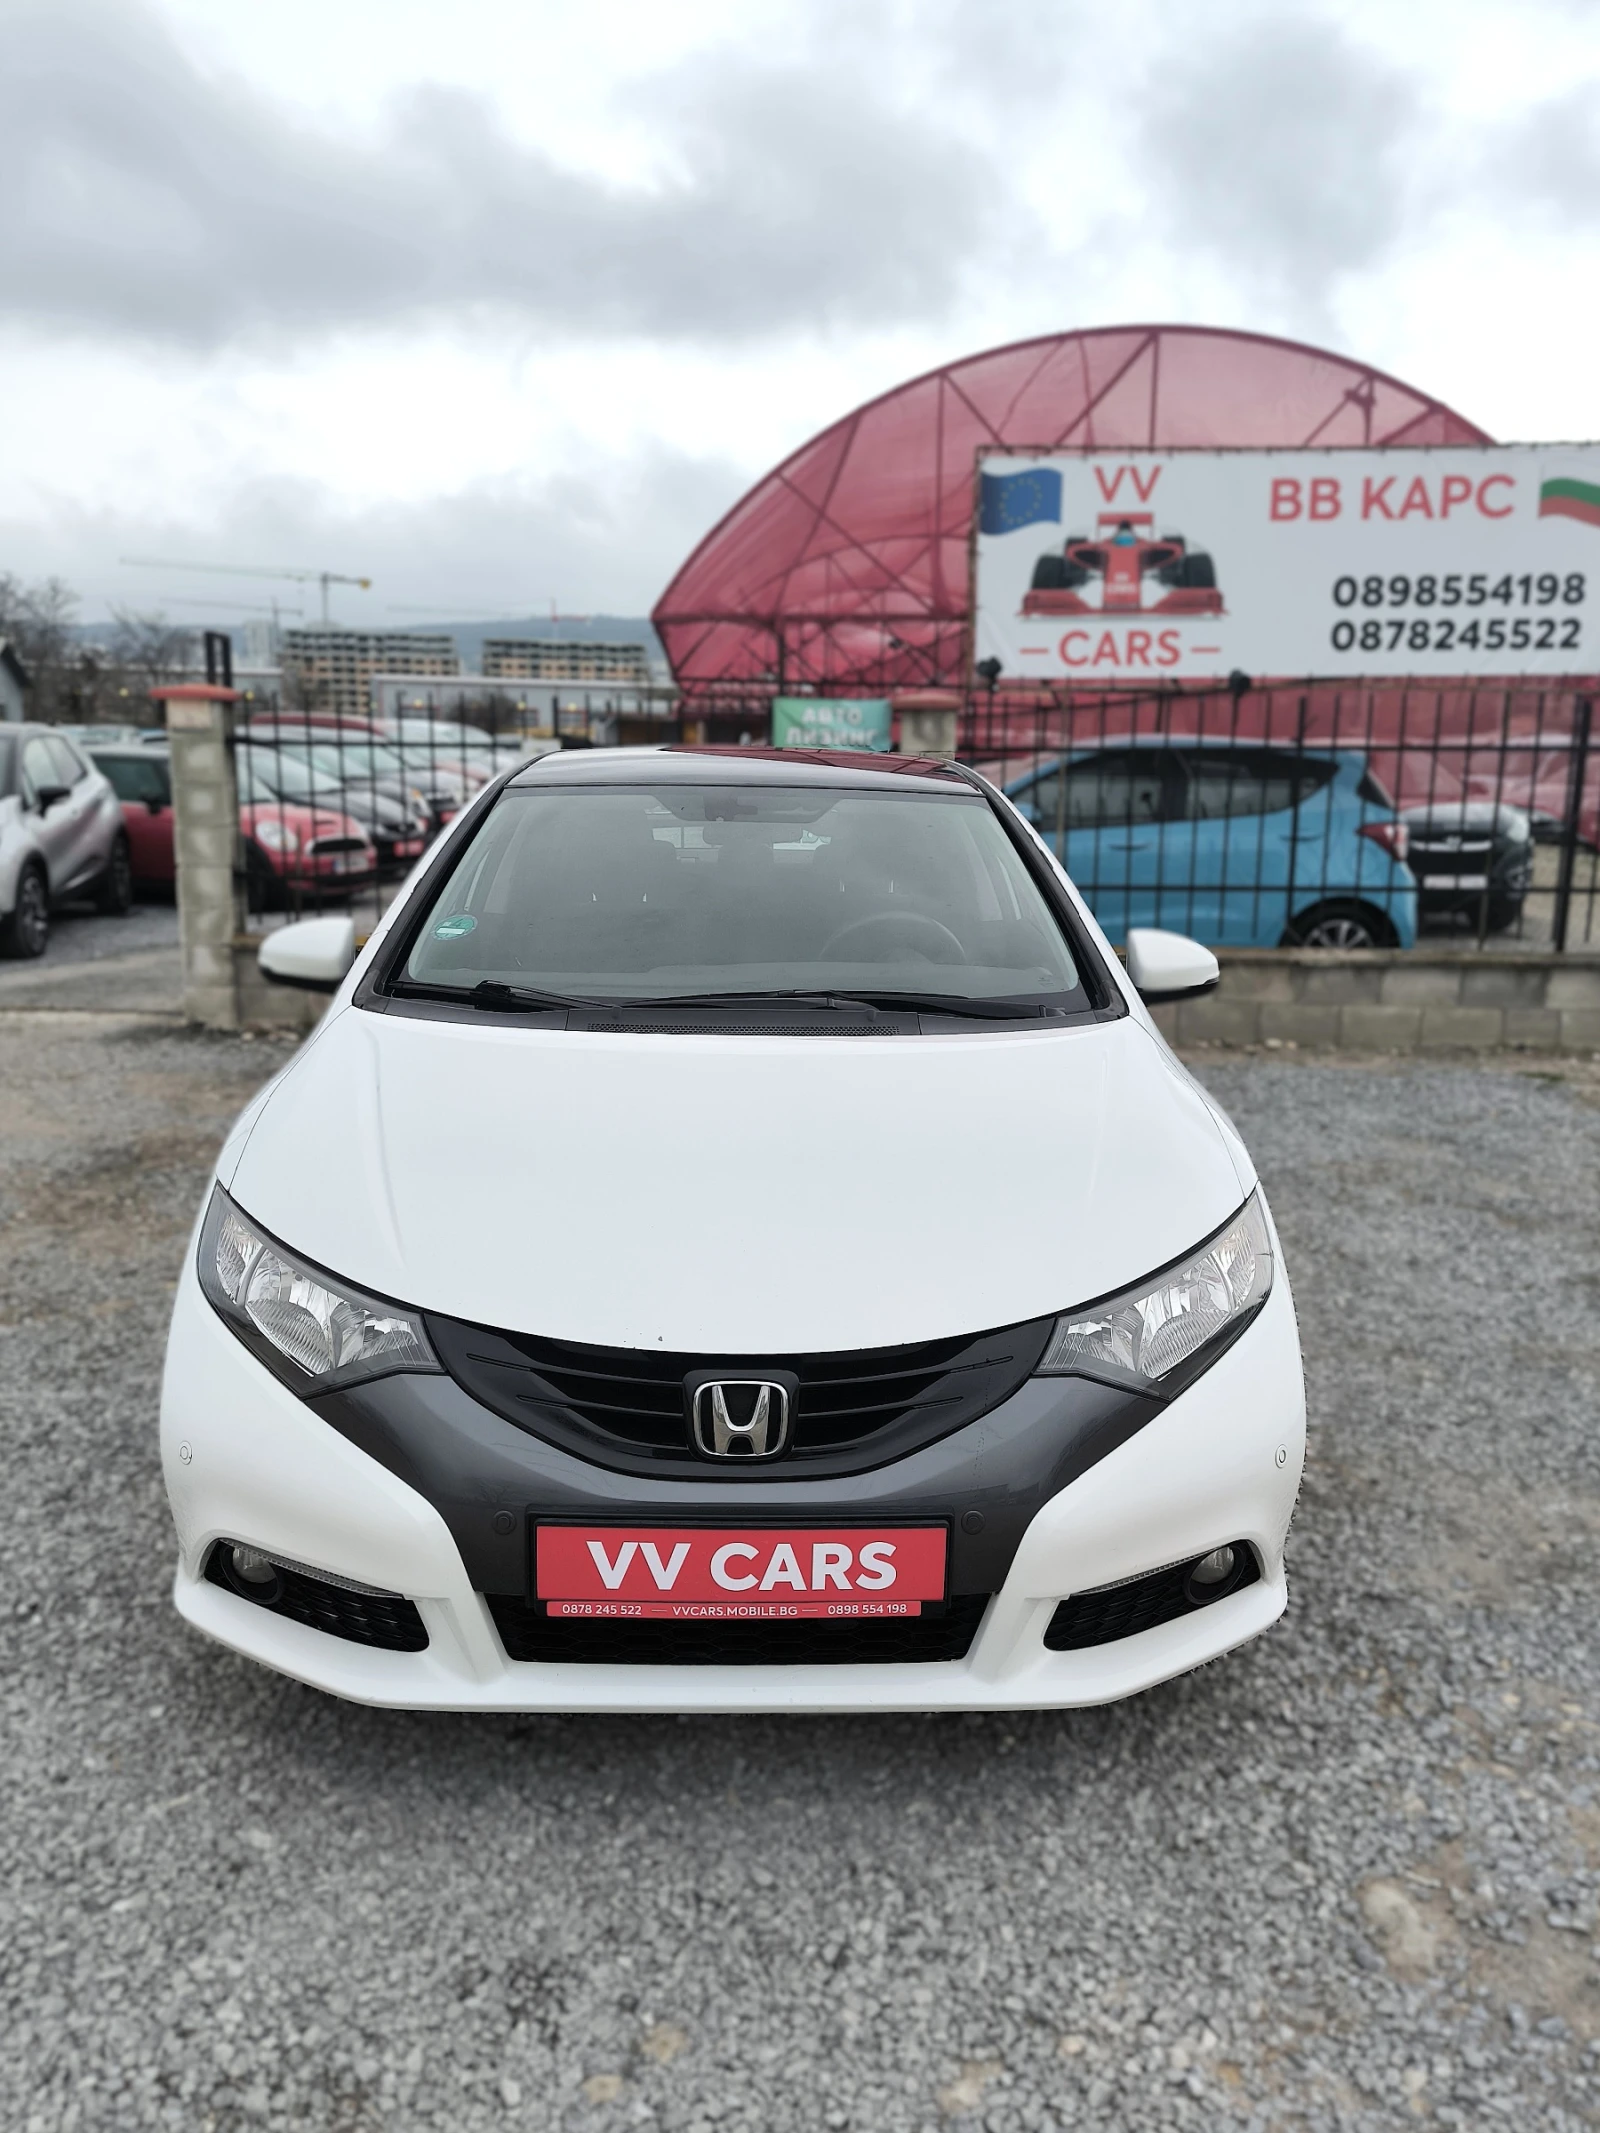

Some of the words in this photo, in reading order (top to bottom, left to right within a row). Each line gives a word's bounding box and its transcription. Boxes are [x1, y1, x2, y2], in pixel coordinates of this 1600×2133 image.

[1095, 467, 1160, 502] VV
[1270, 478, 1342, 522] ВВ
[1362, 474, 1516, 519] КАРС
[1333, 574, 1586, 607] 0898554198
[1058, 630, 1181, 667] CARS
[1331, 618, 1582, 651] 0878245522
[586, 1540, 692, 1591] VV
[709, 1541, 898, 1592] CARS
[561, 1604, 593, 1615] 0878
[595, 1604, 618, 1616] 245
[620, 1604, 642, 1616] 522
[672, 1606, 798, 1617] VVCARS.MOBILE.BG
[827, 1604, 859, 1616] 0898
[862, 1604, 885, 1615] 554
[886, 1603, 907, 1615] 198
